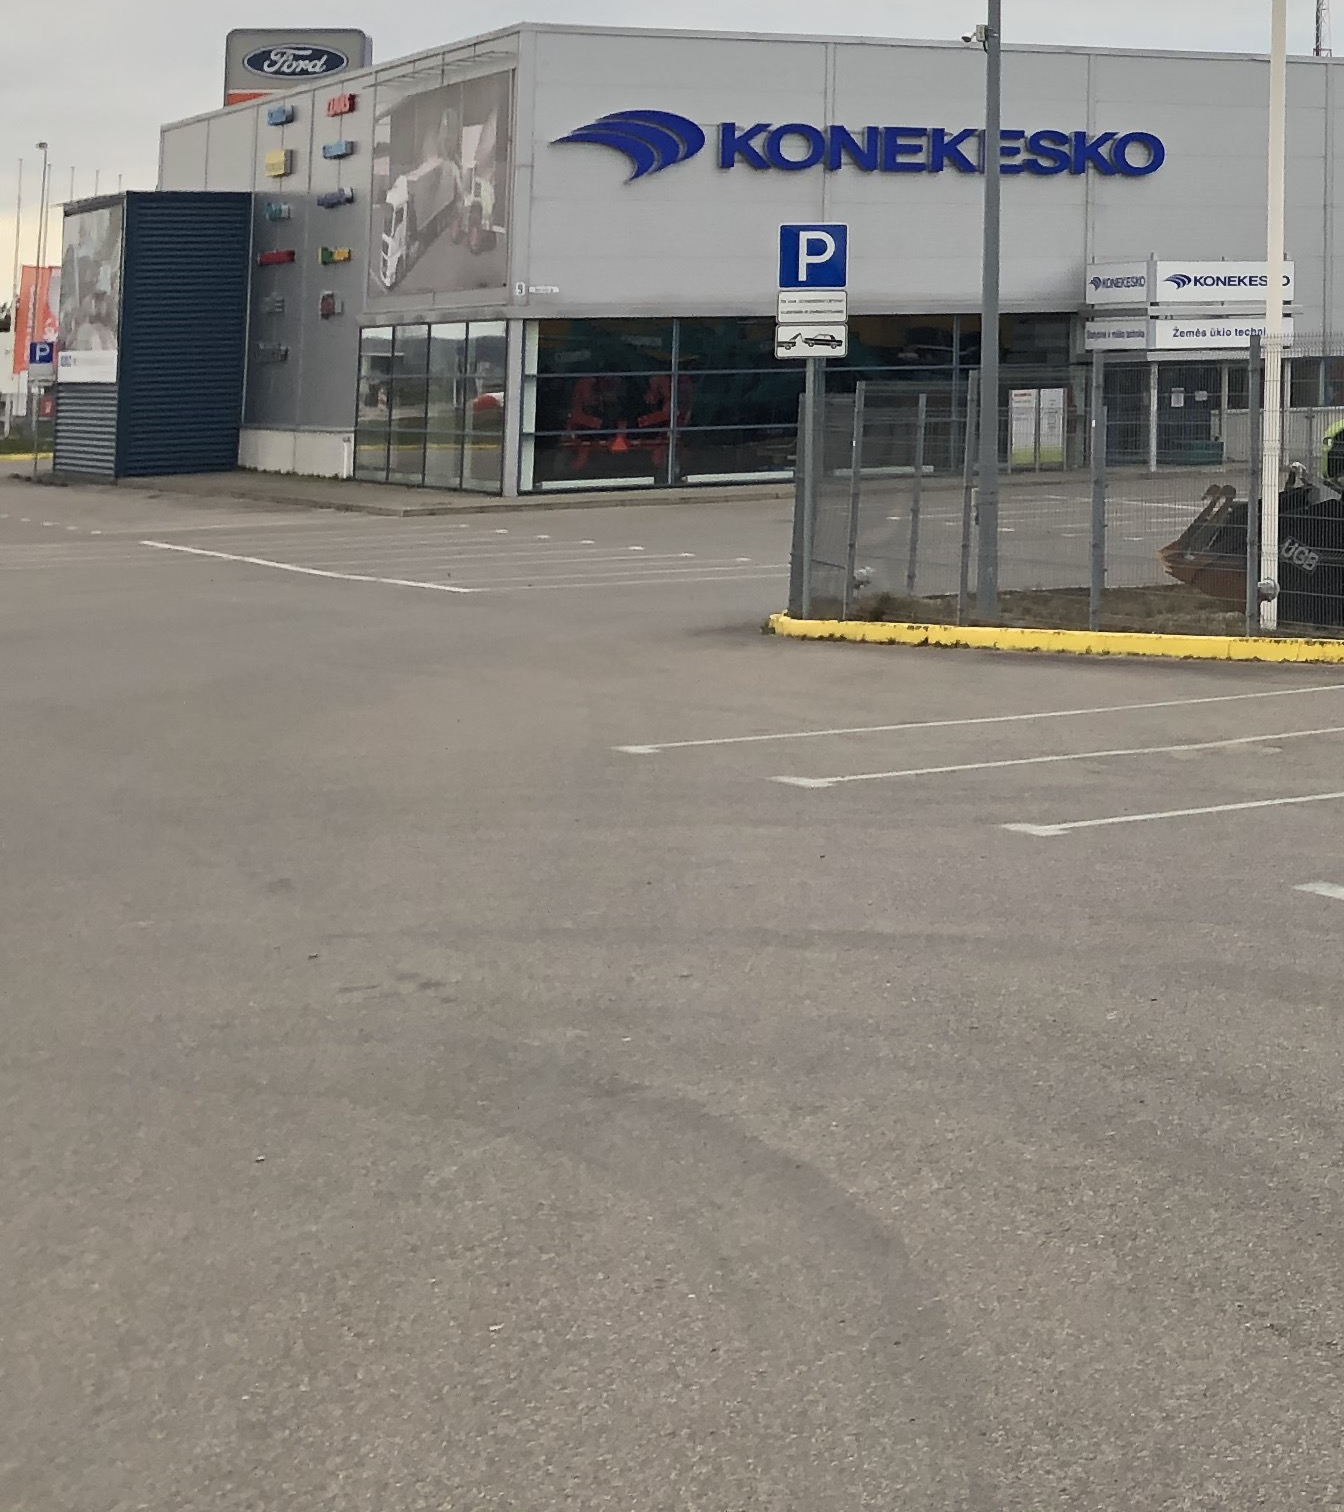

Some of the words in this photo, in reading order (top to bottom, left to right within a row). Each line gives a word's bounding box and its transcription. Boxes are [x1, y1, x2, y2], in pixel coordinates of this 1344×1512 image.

[263, 48, 329, 74] Ford
[719, 122, 1166, 176] KONEKESKO
[798, 231, 836, 282] P
[1101, 275, 1145, 289] KONEKESKO
[1172, 325, 1207, 338] Žemės
[35, 345, 50, 361] P
